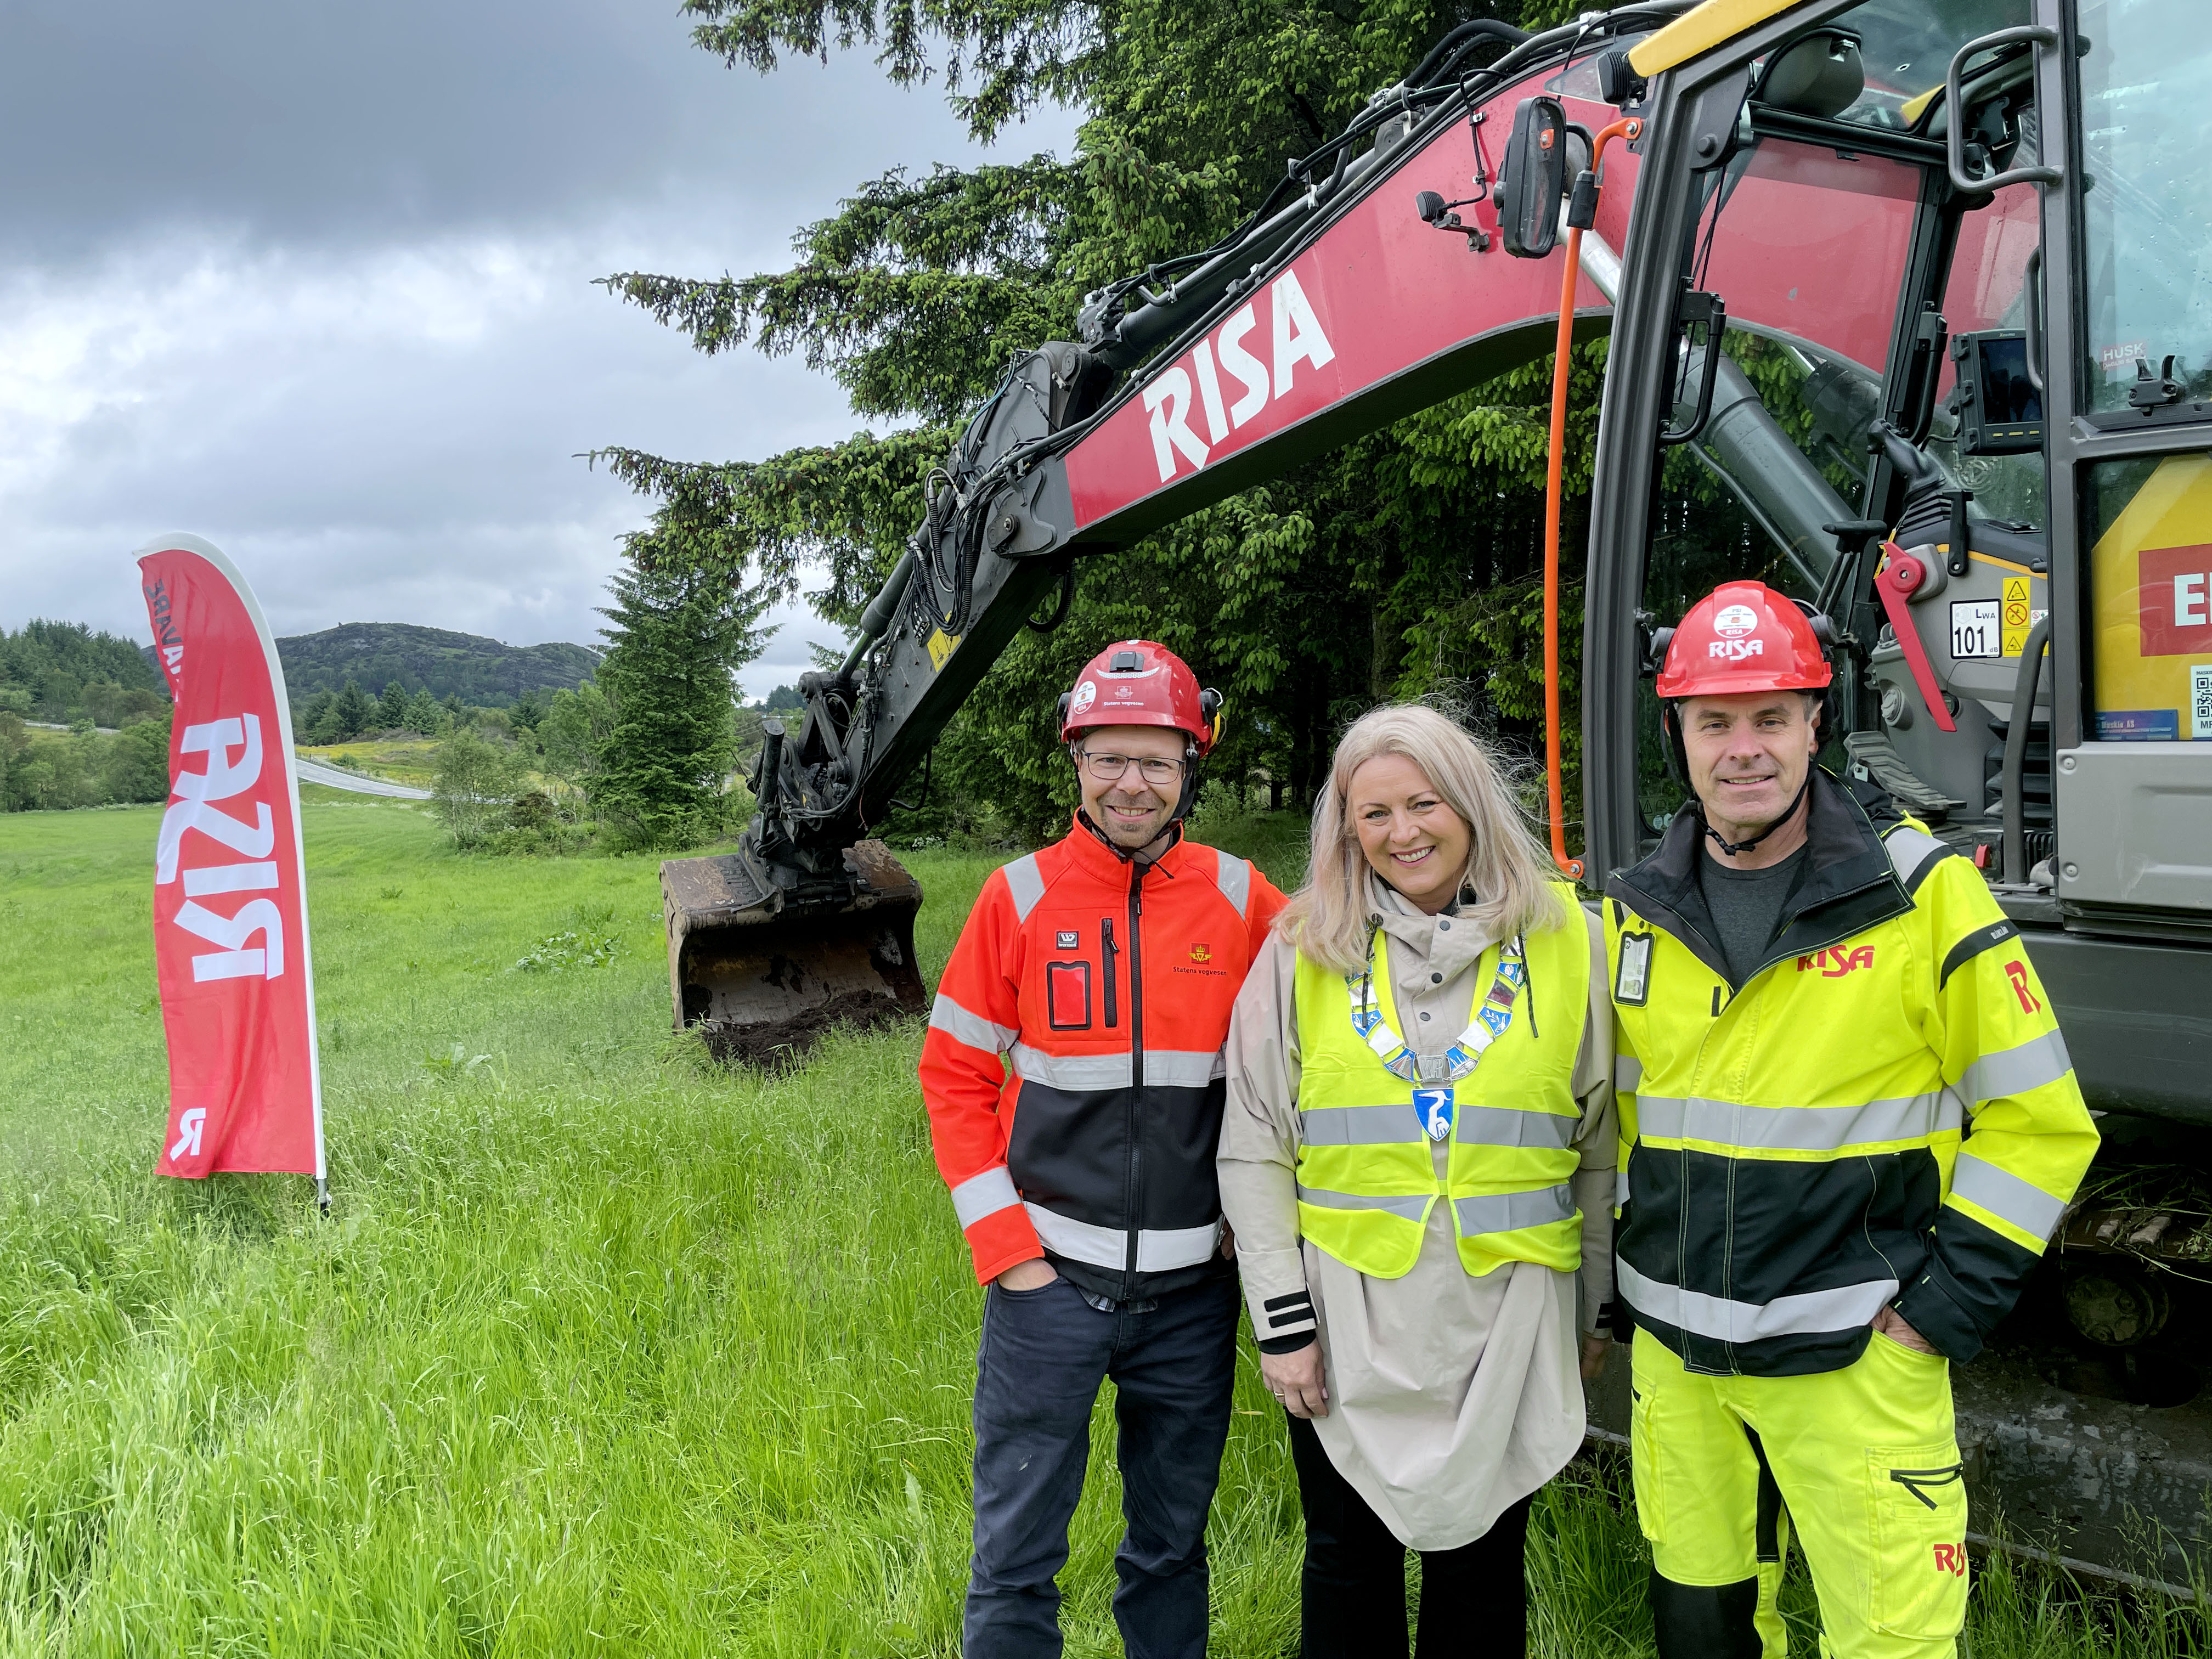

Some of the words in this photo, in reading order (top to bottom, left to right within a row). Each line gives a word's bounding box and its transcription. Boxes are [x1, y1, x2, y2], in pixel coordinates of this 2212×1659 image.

[2104, 342, 2143, 361] HUSK
[1142, 268, 1335, 483] RISA
[2174, 572, 2212, 627] E
[1976, 609, 1996, 619] LWA
[1709, 640, 1763, 661] RISA
[1955, 626, 1984, 654] 101
[2126, 719, 2135, 728] AS
[2004, 960, 2041, 1014] R
